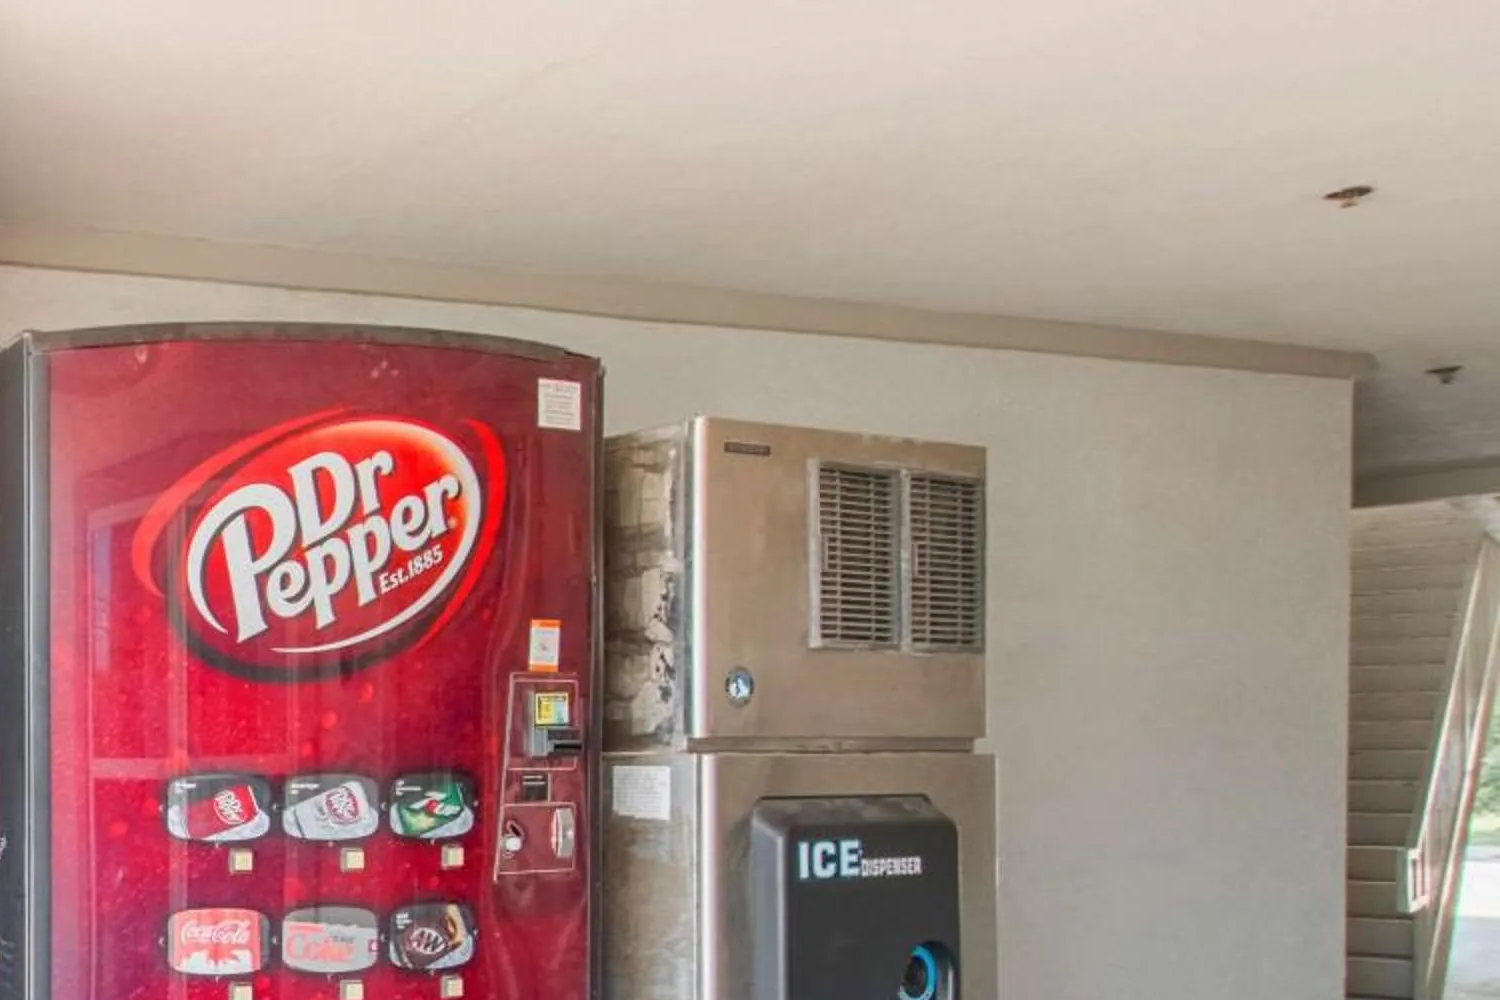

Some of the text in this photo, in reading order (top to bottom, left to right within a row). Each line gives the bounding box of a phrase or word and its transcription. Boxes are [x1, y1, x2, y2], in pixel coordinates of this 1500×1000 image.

[288, 450, 393, 547] Dr
[187, 473, 460, 643] Pepper
[798, 839, 922, 879] ICE DISPENSER
